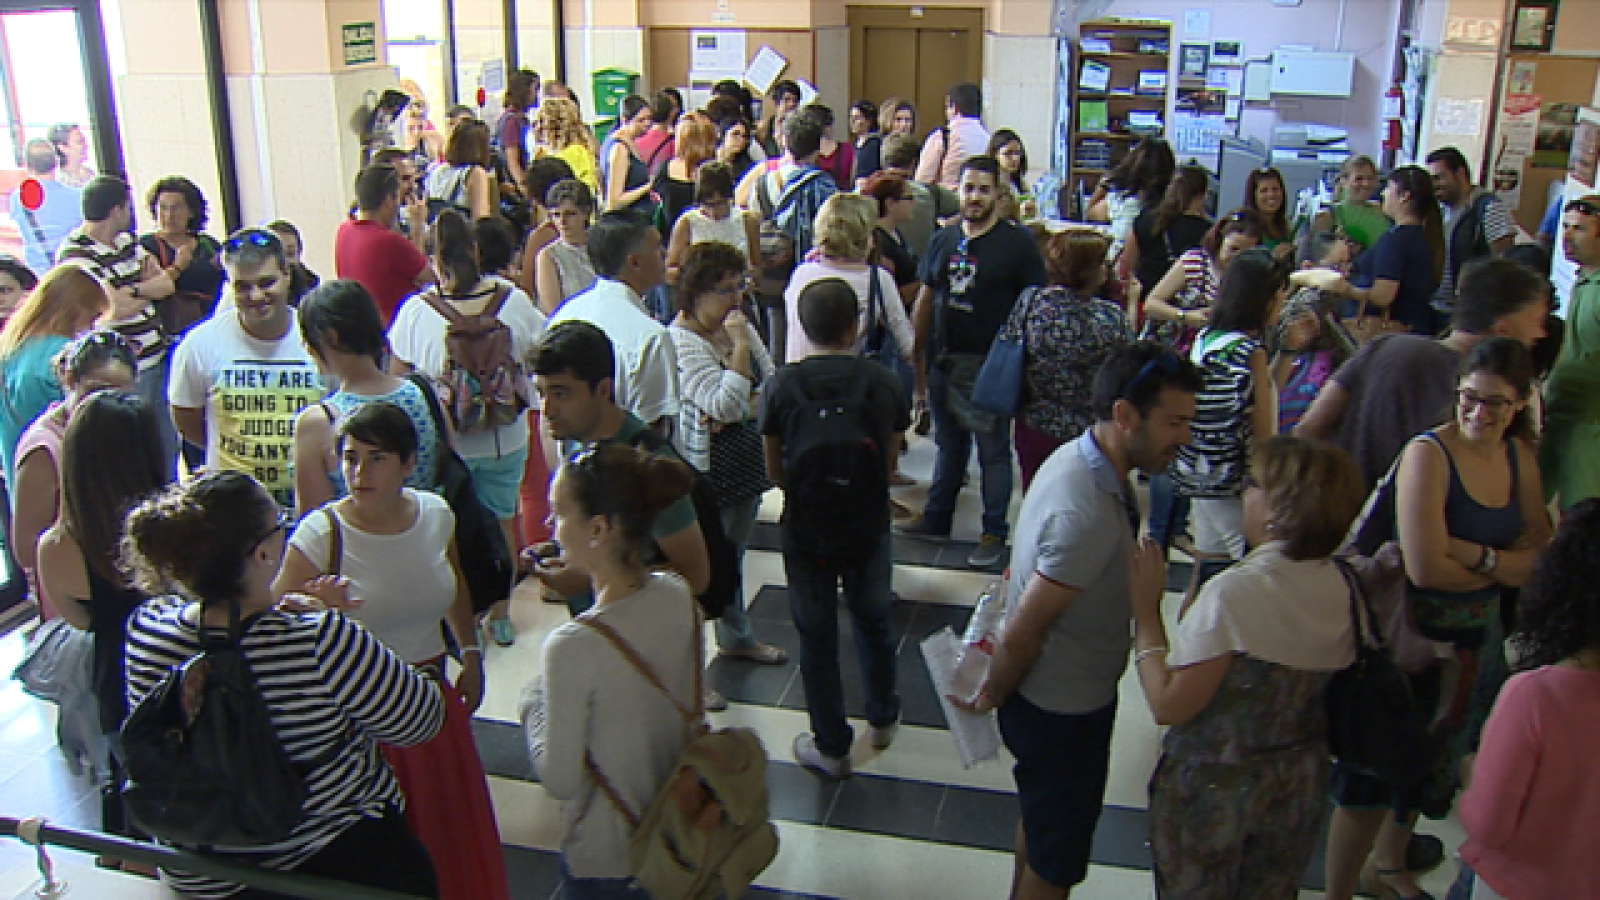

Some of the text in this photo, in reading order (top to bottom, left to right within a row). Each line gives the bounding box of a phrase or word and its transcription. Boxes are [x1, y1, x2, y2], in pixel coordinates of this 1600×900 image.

[223, 369, 314, 388] THEY ARE
[223, 394, 276, 412] GOING
[253, 444, 291, 460] ANY
